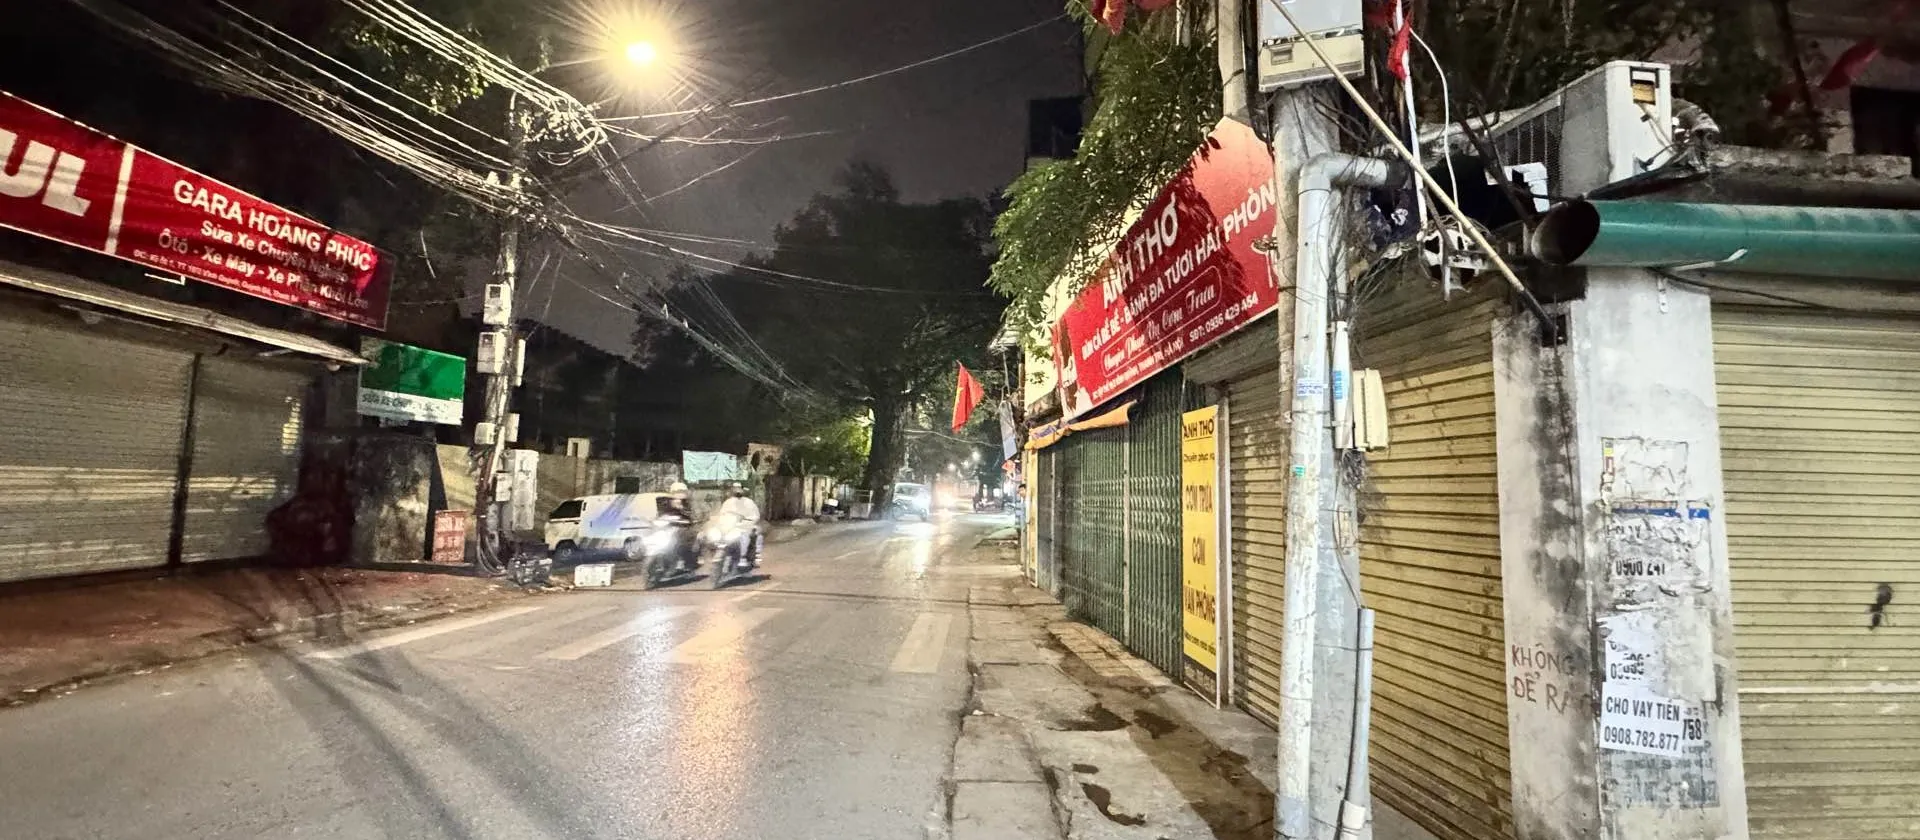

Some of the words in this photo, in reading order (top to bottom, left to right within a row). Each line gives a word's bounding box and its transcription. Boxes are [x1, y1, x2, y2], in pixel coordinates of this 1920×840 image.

[173, 179, 243, 225] GARA
[248, 207, 321, 252] HOÀNG
[325, 239, 371, 271] PHÚC
[201, 219, 233, 244] Sửa
[236, 231, 255, 250] Xe
[1149, 277, 1165, 303] ĐA
[1164, 249, 1194, 289] TƯƠI
[1223, 178, 1276, 242] PHÒN
[202, 245, 223, 265] Xe
[267, 266, 285, 284] Xe
[1103, 243, 1133, 309] ANH
[1134, 191, 1178, 271] THƠ
[1184, 422, 1197, 438] ANH
[1511, 643, 1575, 677] KHÔNG
[1511, 671, 1538, 703] ĐỂ
[1606, 696, 1629, 715] CHO
[1632, 699, 1653, 718] VAY
[1604, 725, 1680, 751] 0908.782.877
